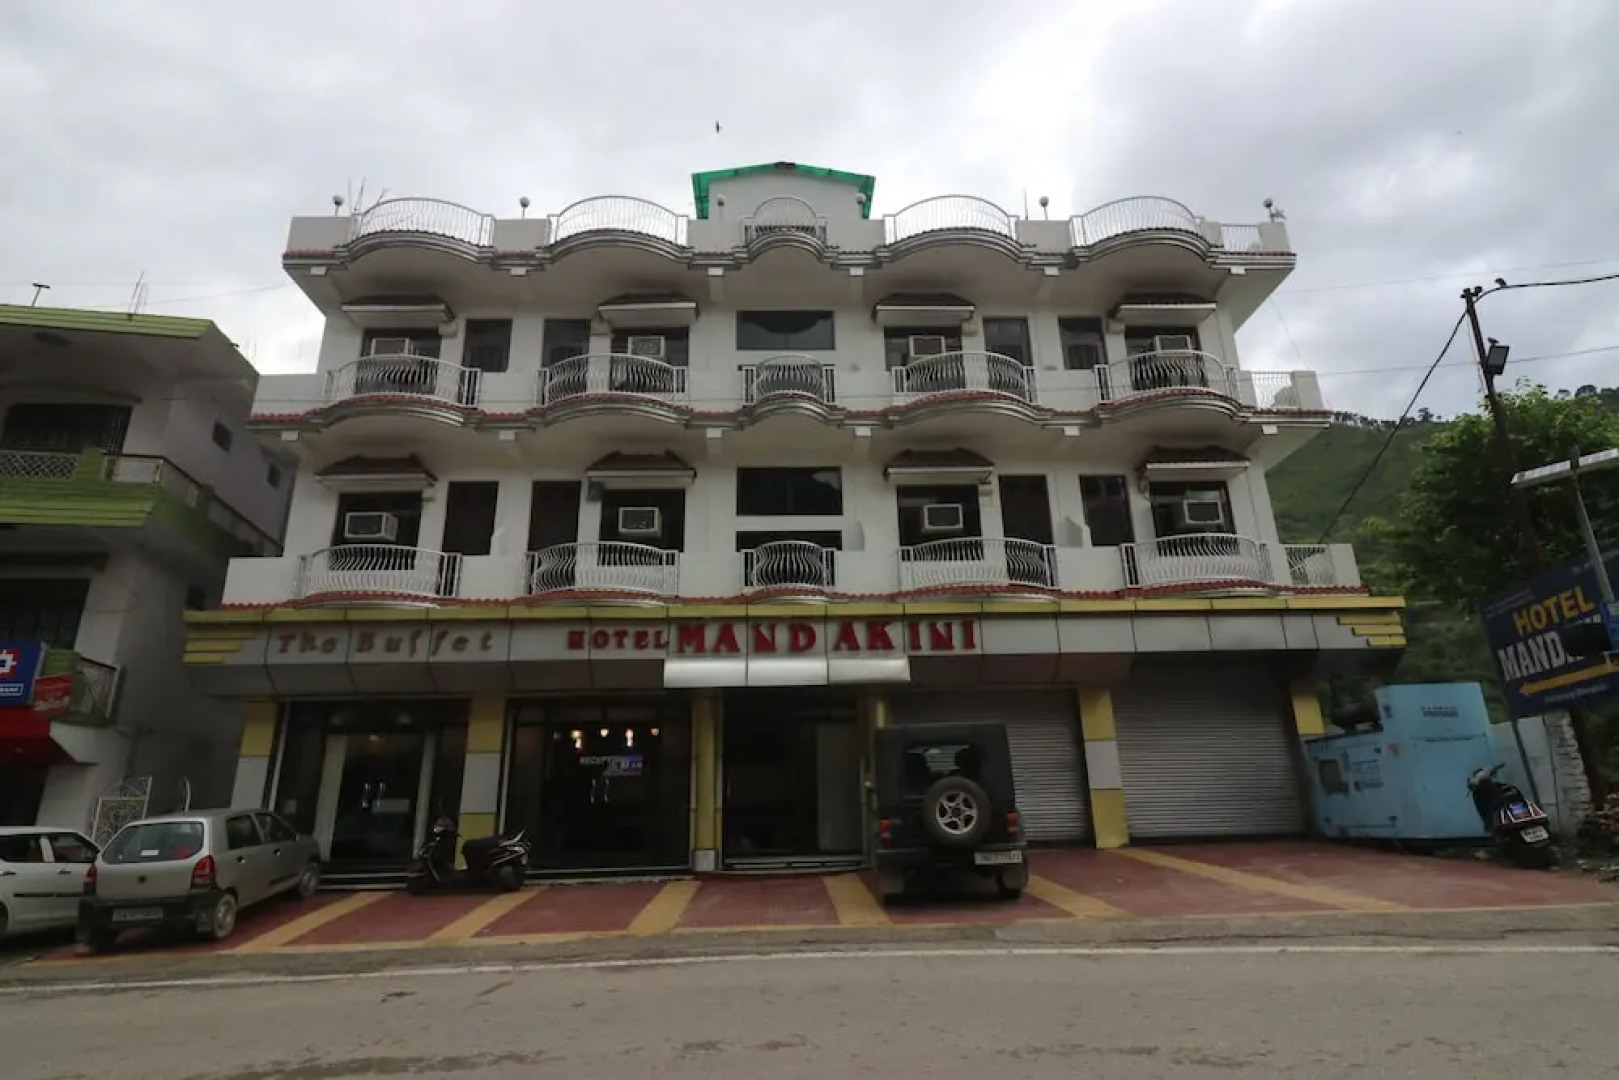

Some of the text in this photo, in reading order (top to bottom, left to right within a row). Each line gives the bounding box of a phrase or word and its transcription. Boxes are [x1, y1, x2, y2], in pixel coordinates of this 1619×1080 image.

[1513, 585, 1596, 636] HOTEL
[277, 628, 493, 657] The Buffet
[567, 619, 976, 654] HOTEL MANDAKINI
